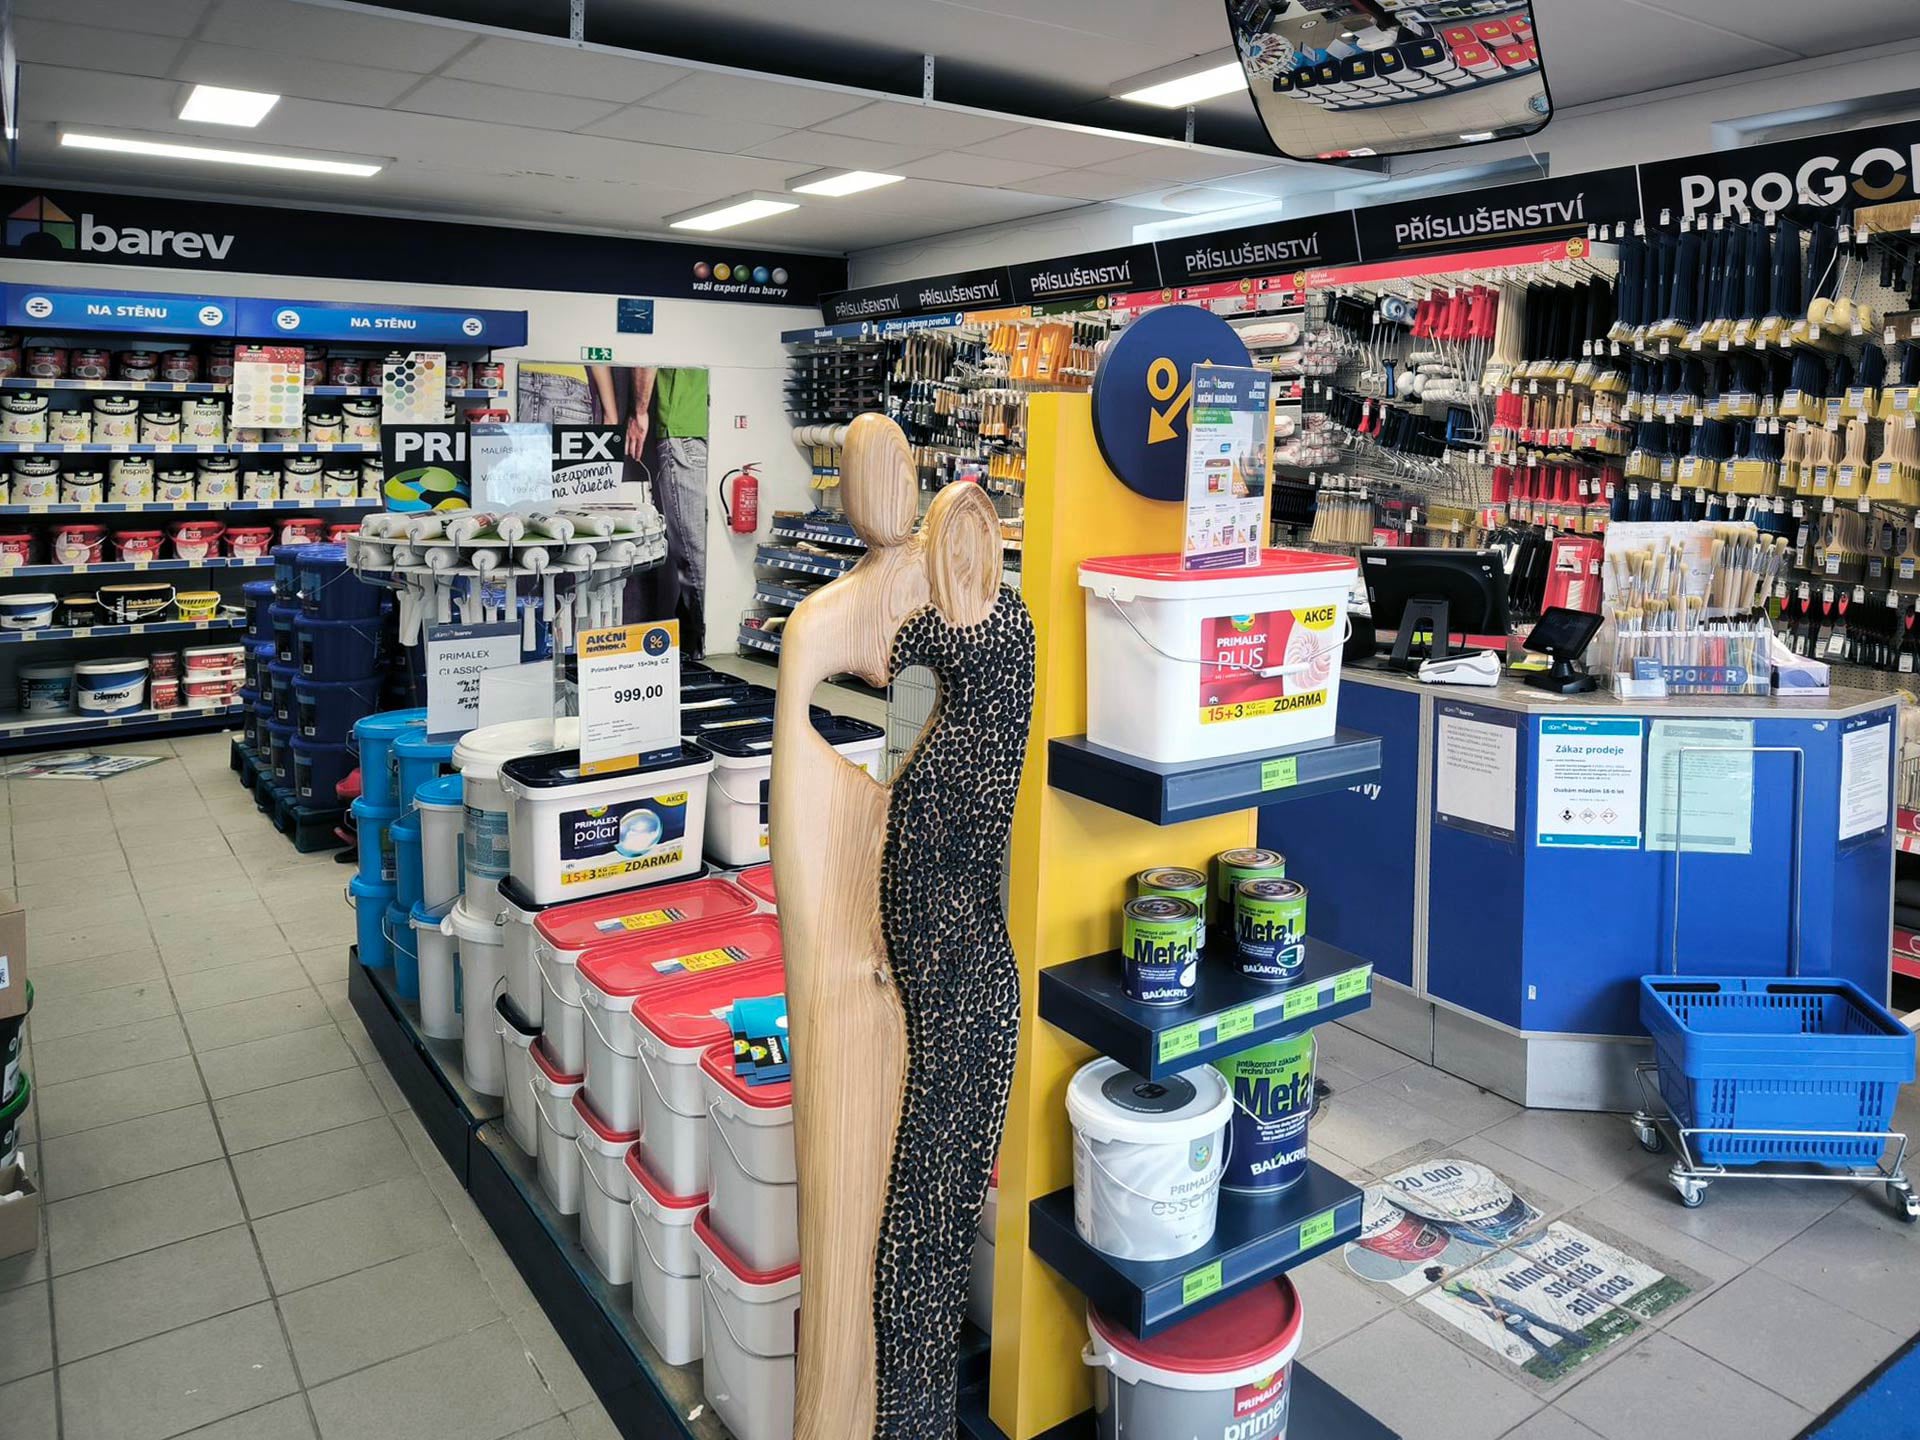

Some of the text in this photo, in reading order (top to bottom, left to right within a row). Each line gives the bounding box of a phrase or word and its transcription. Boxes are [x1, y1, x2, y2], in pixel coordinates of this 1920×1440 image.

[1680, 144, 1920, 224] PROGO
[1395, 192, 1585, 244] PŘÍSLUŠENSTVÍ
[81, 213, 235, 260] barev
[1185, 232, 1319, 272] PŘÍSLUŠENSTVÍ
[1030, 260, 1131, 292] PŘÍSLUŠENSTVÍ
[692, 281, 789, 298] vaši experti na barvy
[919, 278, 999, 306] PŘÍSLUŠENSTVÍ
[87, 304, 168, 319] NA STĚNU
[835, 293, 900, 317] PŘÍSLUŠENSTVÍ
[351, 316, 417, 330] NA STĚNU
[1217, 379, 1235, 389] barev
[574, 478, 617, 496] váleček
[1304, 608, 1333, 623] AKCE
[586, 630, 627, 645] AKČNÍ
[1216, 634, 1267, 648] PRIMALEX
[440, 650, 490, 661] PRIMALEX
[1218, 648, 1264, 672] PLUS
[614, 684, 664, 704] 999,00
[1273, 692, 1322, 712] ZDARMA
[1207, 704, 1244, 721] 15+3
[1555, 744, 1625, 756] Zákaz prodeje
[665, 793, 686, 804] AKCE
[574, 816, 619, 830] PRIMALEX
[574, 825, 619, 846] polar
[624, 851, 680, 873] ZDARMA
[566, 869, 597, 884] 15+3
[1240, 918, 1295, 942] Metal
[1134, 936, 1193, 965] Metal
[1242, 963, 1289, 976] BALAKRYL
[1141, 988, 1188, 1000] BALAKRYL
[1394, 1164, 1463, 1192] 20 000
[1543, 1258, 1605, 1300] snadná
[1566, 1273, 1635, 1318] aplikace
[1237, 1378, 1284, 1412] PRIMALEX
[1224, 1391, 1287, 1440] primer
